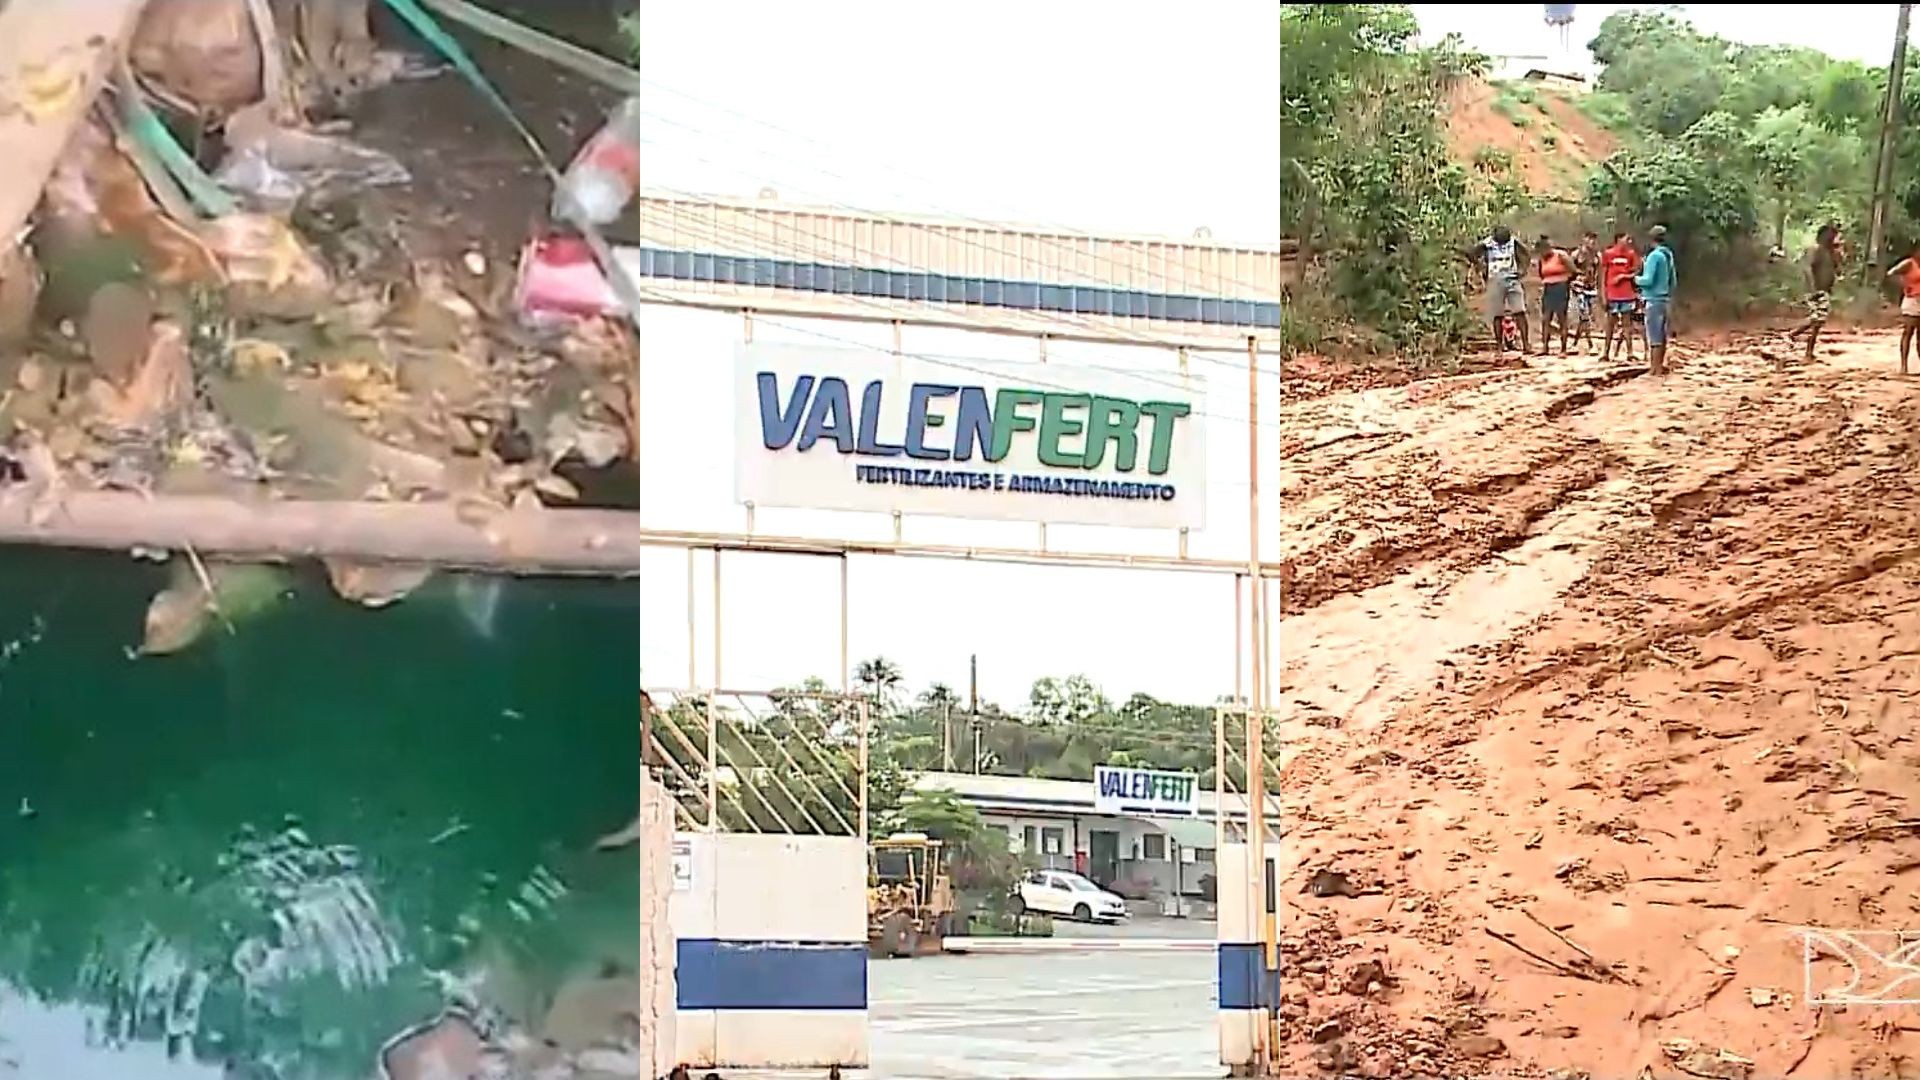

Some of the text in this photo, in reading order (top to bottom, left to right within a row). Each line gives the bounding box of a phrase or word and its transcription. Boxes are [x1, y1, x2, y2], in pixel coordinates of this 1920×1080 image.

[757, 372, 1191, 475] VALENFERT
[856, 464, 1176, 501] FERTILIZANTES E ARMAZENAMENTO
[1100, 770, 1195, 802] VALENFERT
